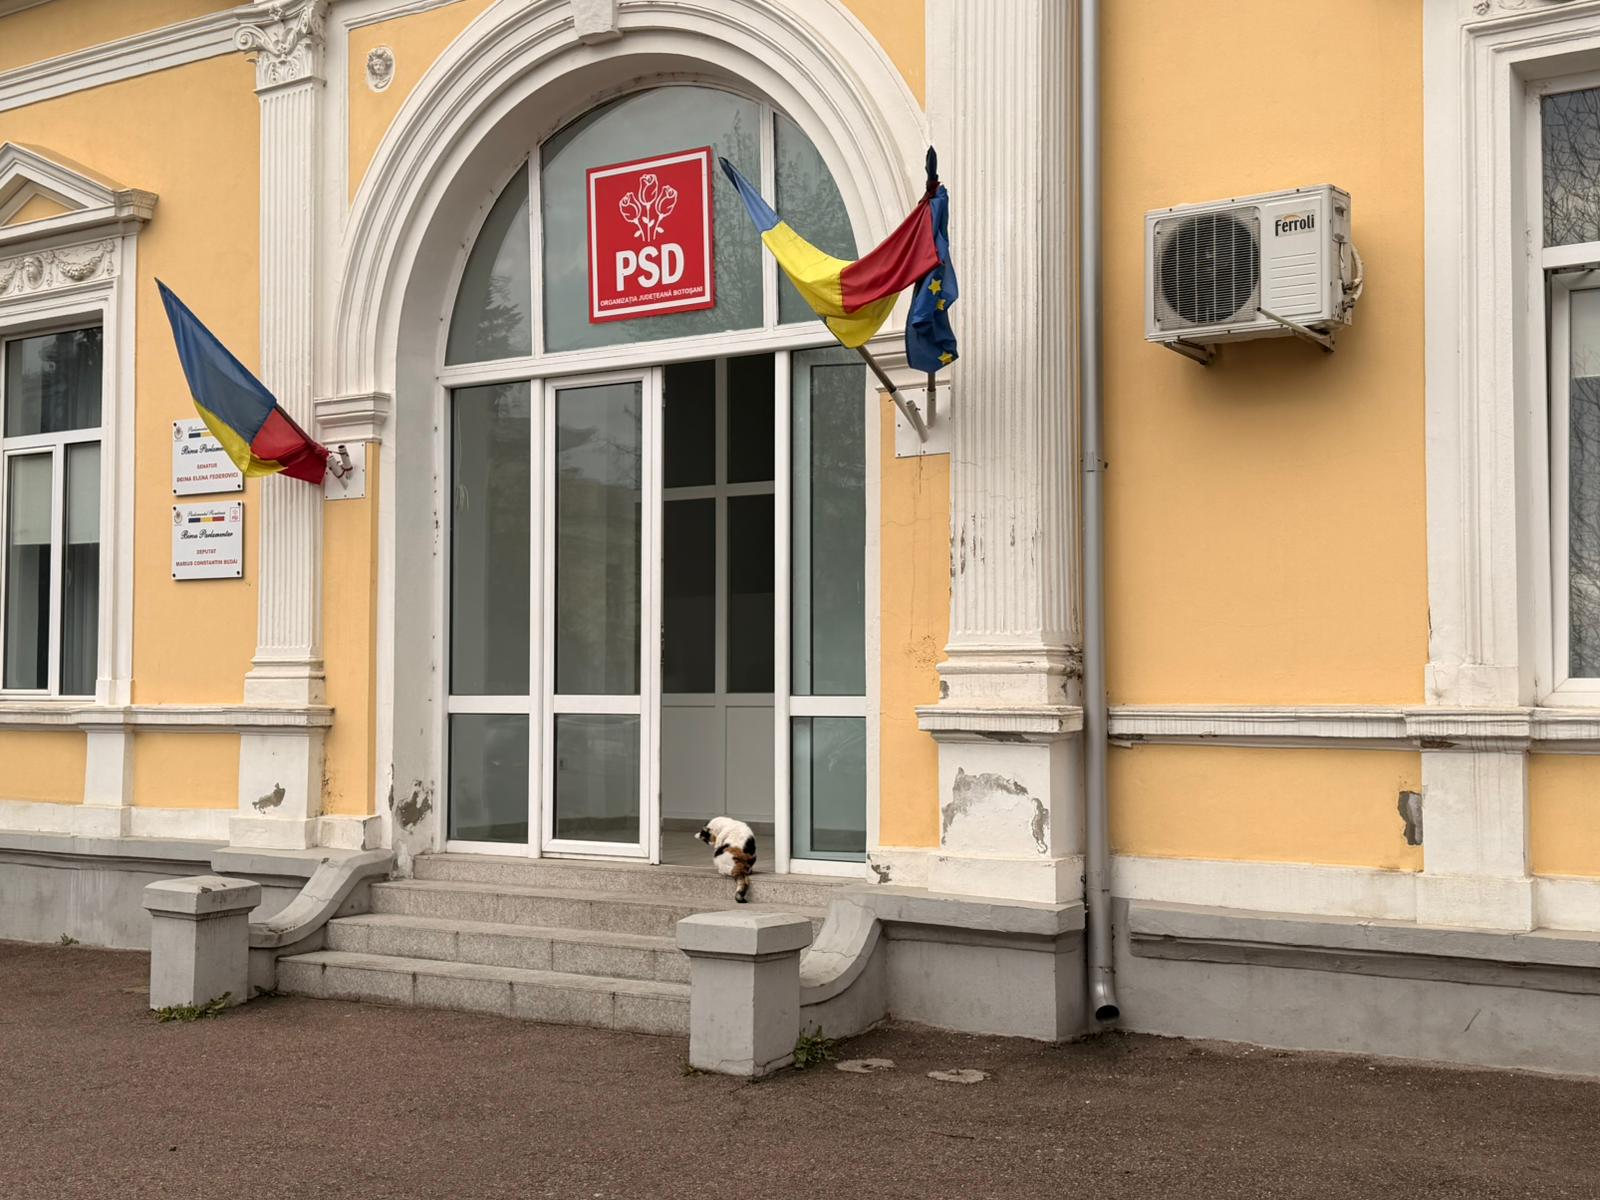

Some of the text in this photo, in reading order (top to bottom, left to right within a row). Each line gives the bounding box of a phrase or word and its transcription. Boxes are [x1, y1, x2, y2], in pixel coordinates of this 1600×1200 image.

[1275, 214, 1315, 236] Ferroli
[616, 243, 684, 291] PSD
[209, 472, 238, 480] FEDEROVICI
[199, 529, 233, 539] Parlamentar
